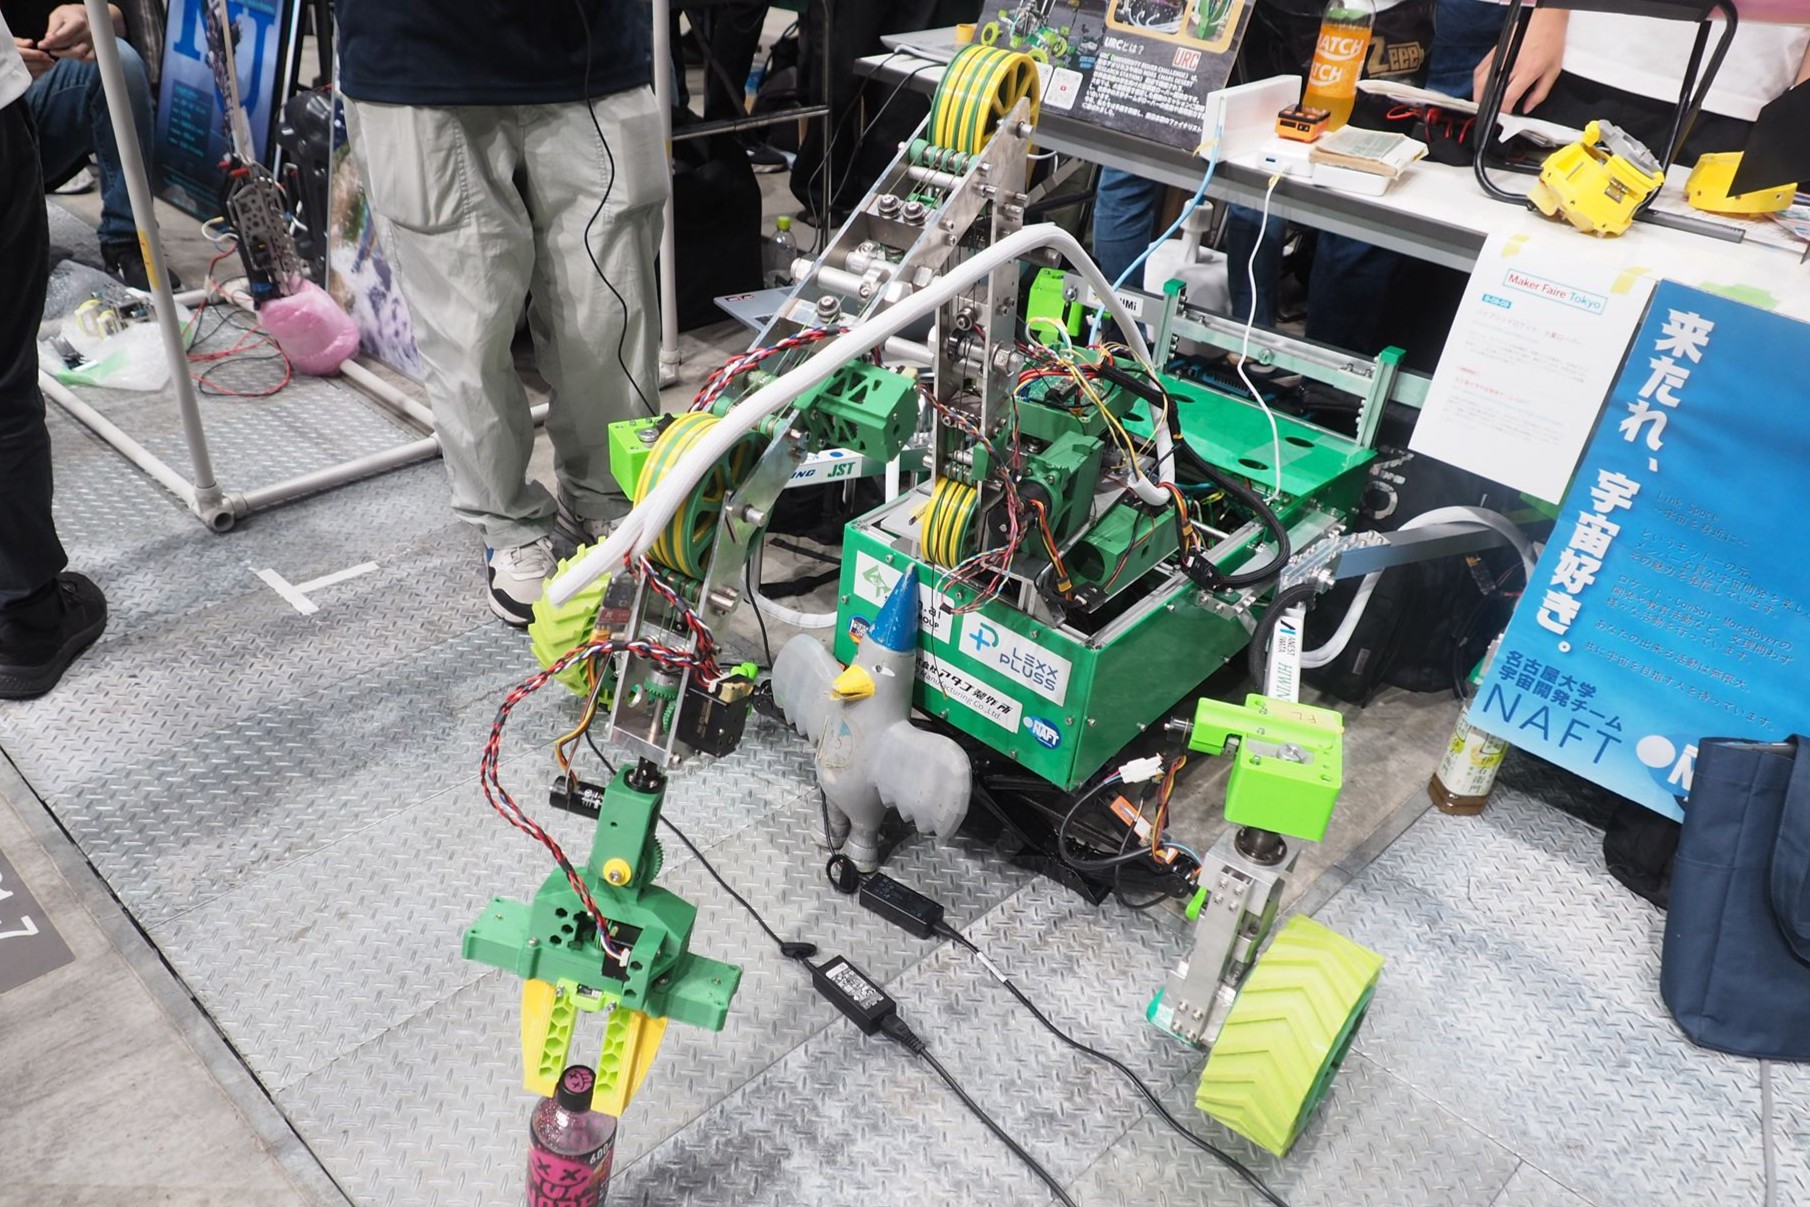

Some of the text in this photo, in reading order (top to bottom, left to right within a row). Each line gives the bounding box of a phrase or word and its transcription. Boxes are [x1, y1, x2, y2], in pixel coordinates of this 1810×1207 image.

[1174, 49, 1200, 70] URC
[1318, 34, 1363, 55] ATCH
[1508, 273, 1601, 310] Maker Faire Tokyo
[827, 462, 856, 478] JST
[1000, 653, 1056, 692] PLUSS
[1013, 647, 1059, 680] LEXX
[1506, 650, 1598, 700] 名古屋大学
[1032, 719, 1060, 746] NAFT
[1483, 683, 1623, 764] NAFT
